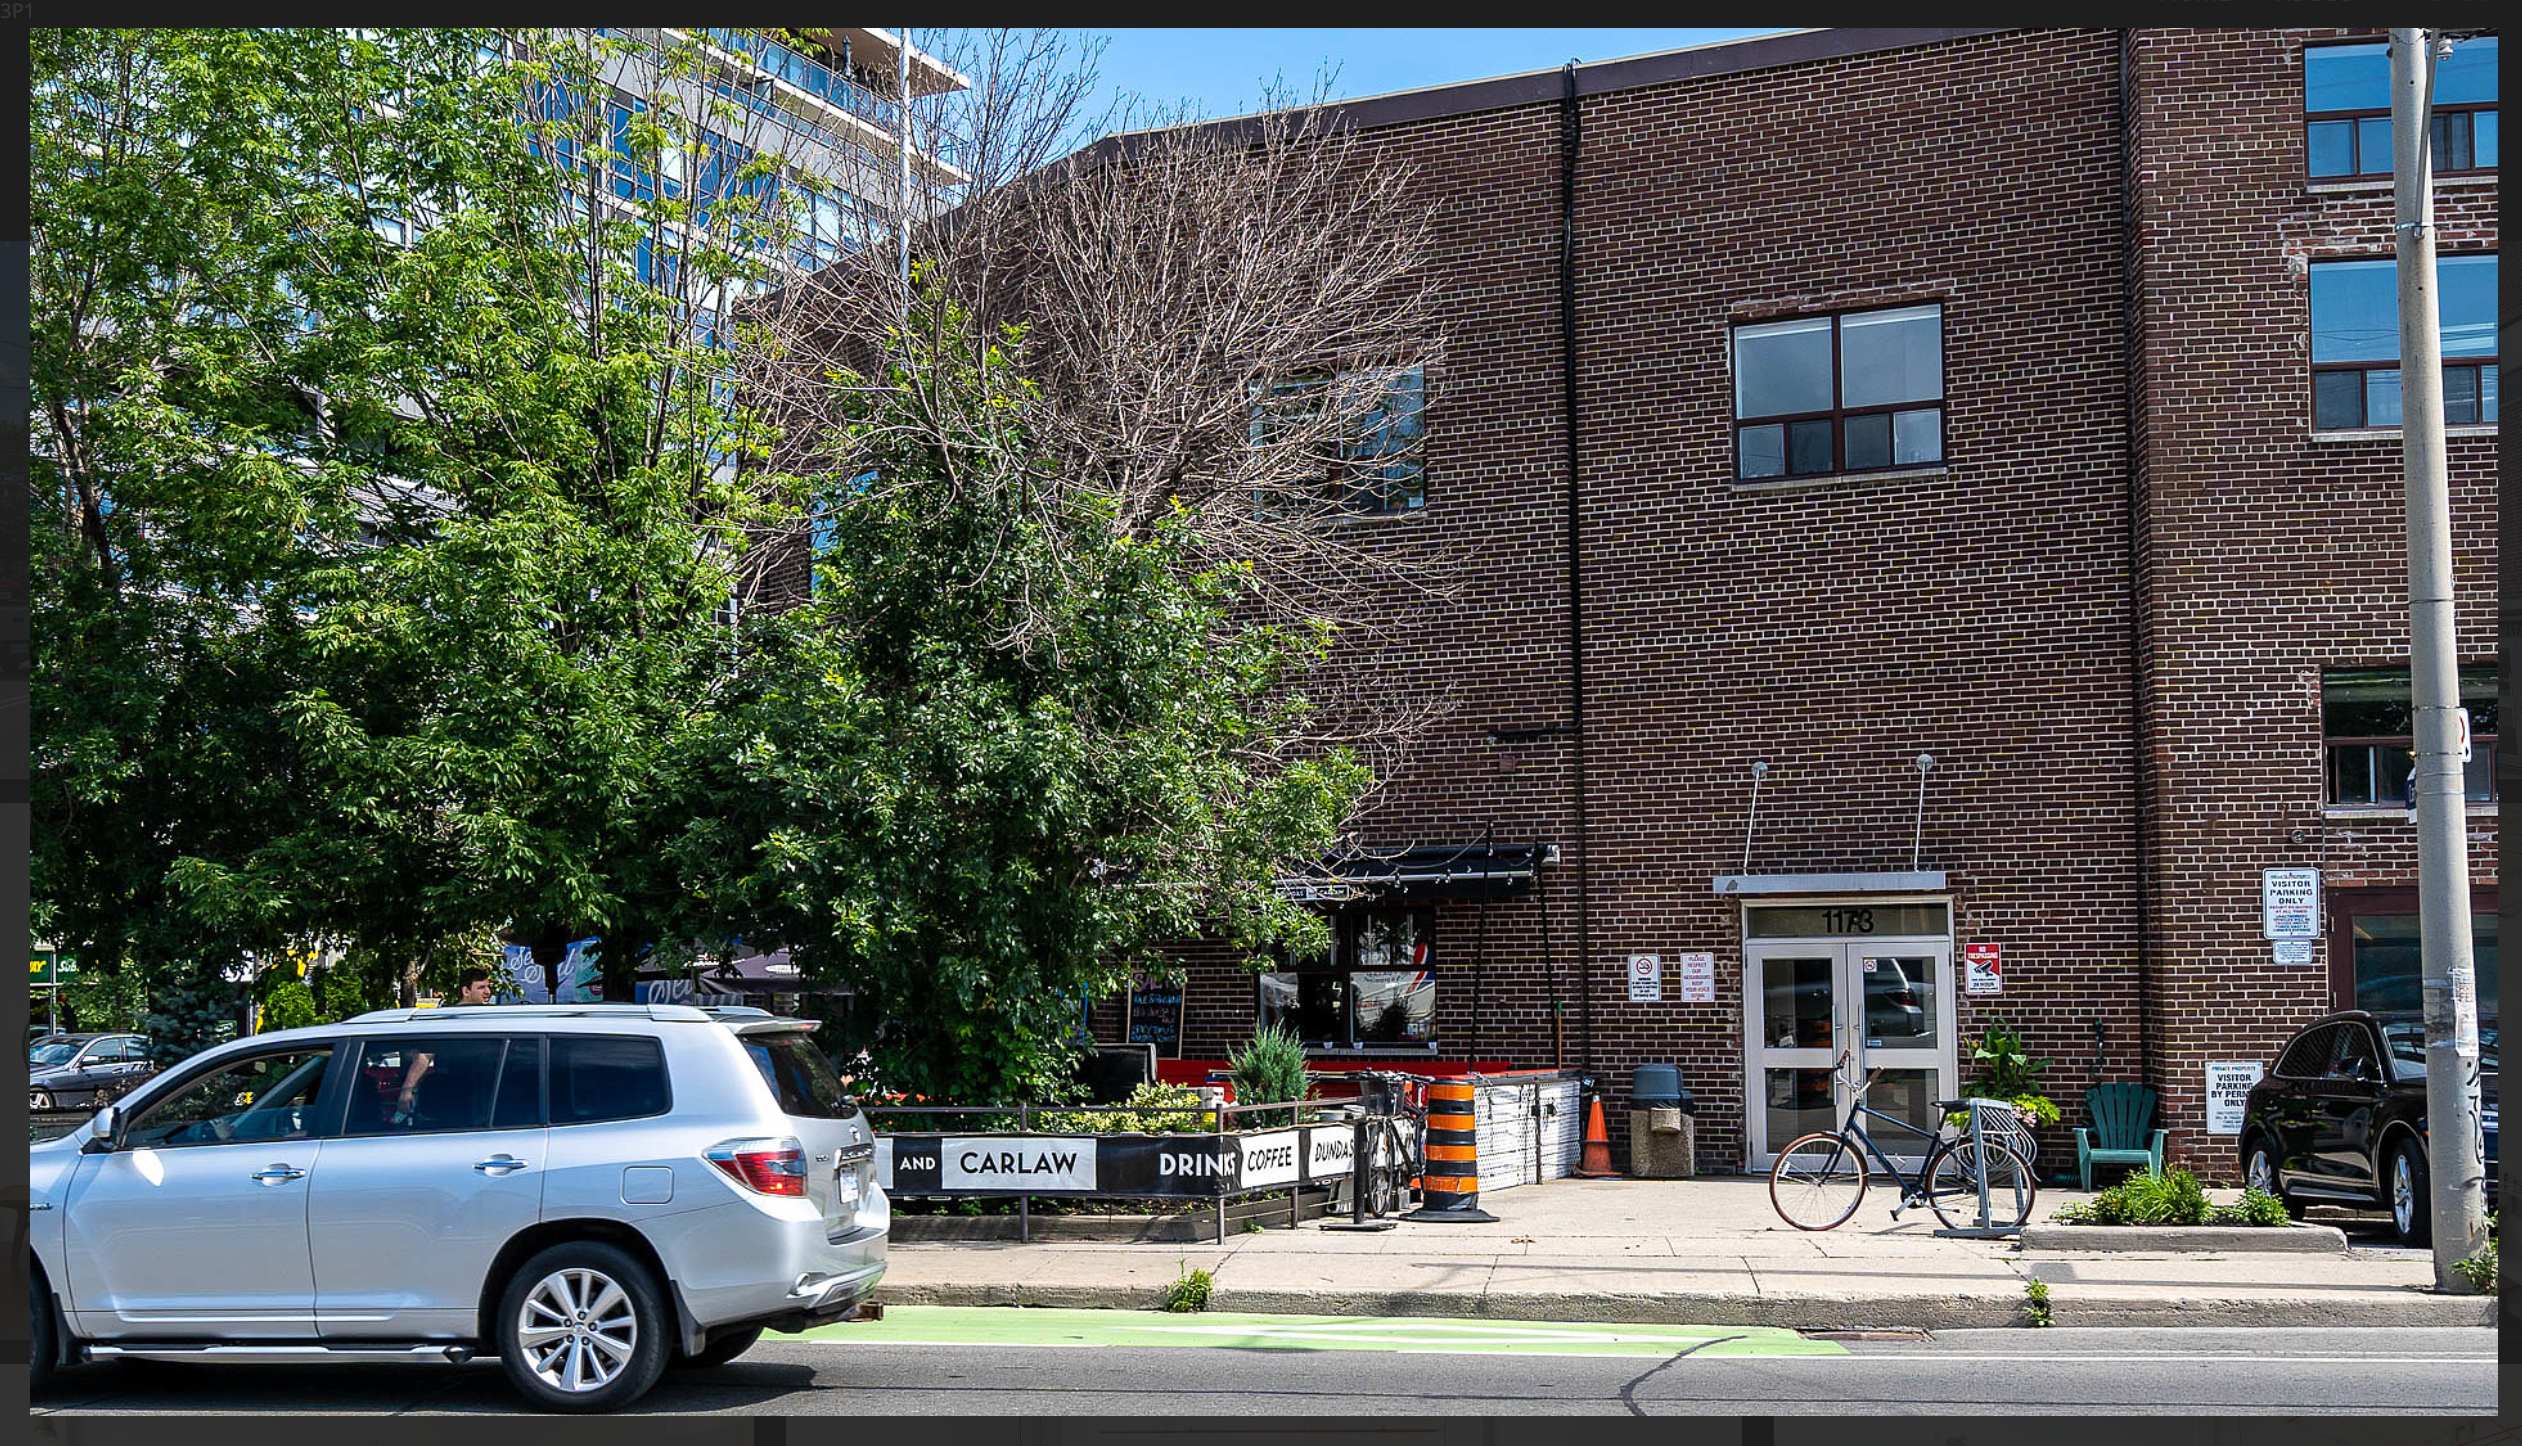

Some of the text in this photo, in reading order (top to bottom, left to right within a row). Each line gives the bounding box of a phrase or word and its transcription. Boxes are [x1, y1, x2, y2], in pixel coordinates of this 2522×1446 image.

[2271, 880, 2311, 888] VISITOR
[2269, 888, 2313, 897] PARKING
[2278, 897, 2305, 905] ONLY
[2217, 1073, 2252, 1081] VISITOR
[2216, 1082, 2253, 1090] PARKING
[2210, 1090, 2223, 1098] BY
[2224, 1099, 2246, 1107] ONLY
[1314, 1140, 1355, 1162] DUNDAS
[1246, 1145, 1293, 1172] COFFEE
[900, 1151, 1077, 1175] AND CARLAW
[1159, 1152, 1236, 1177] DRINKS
